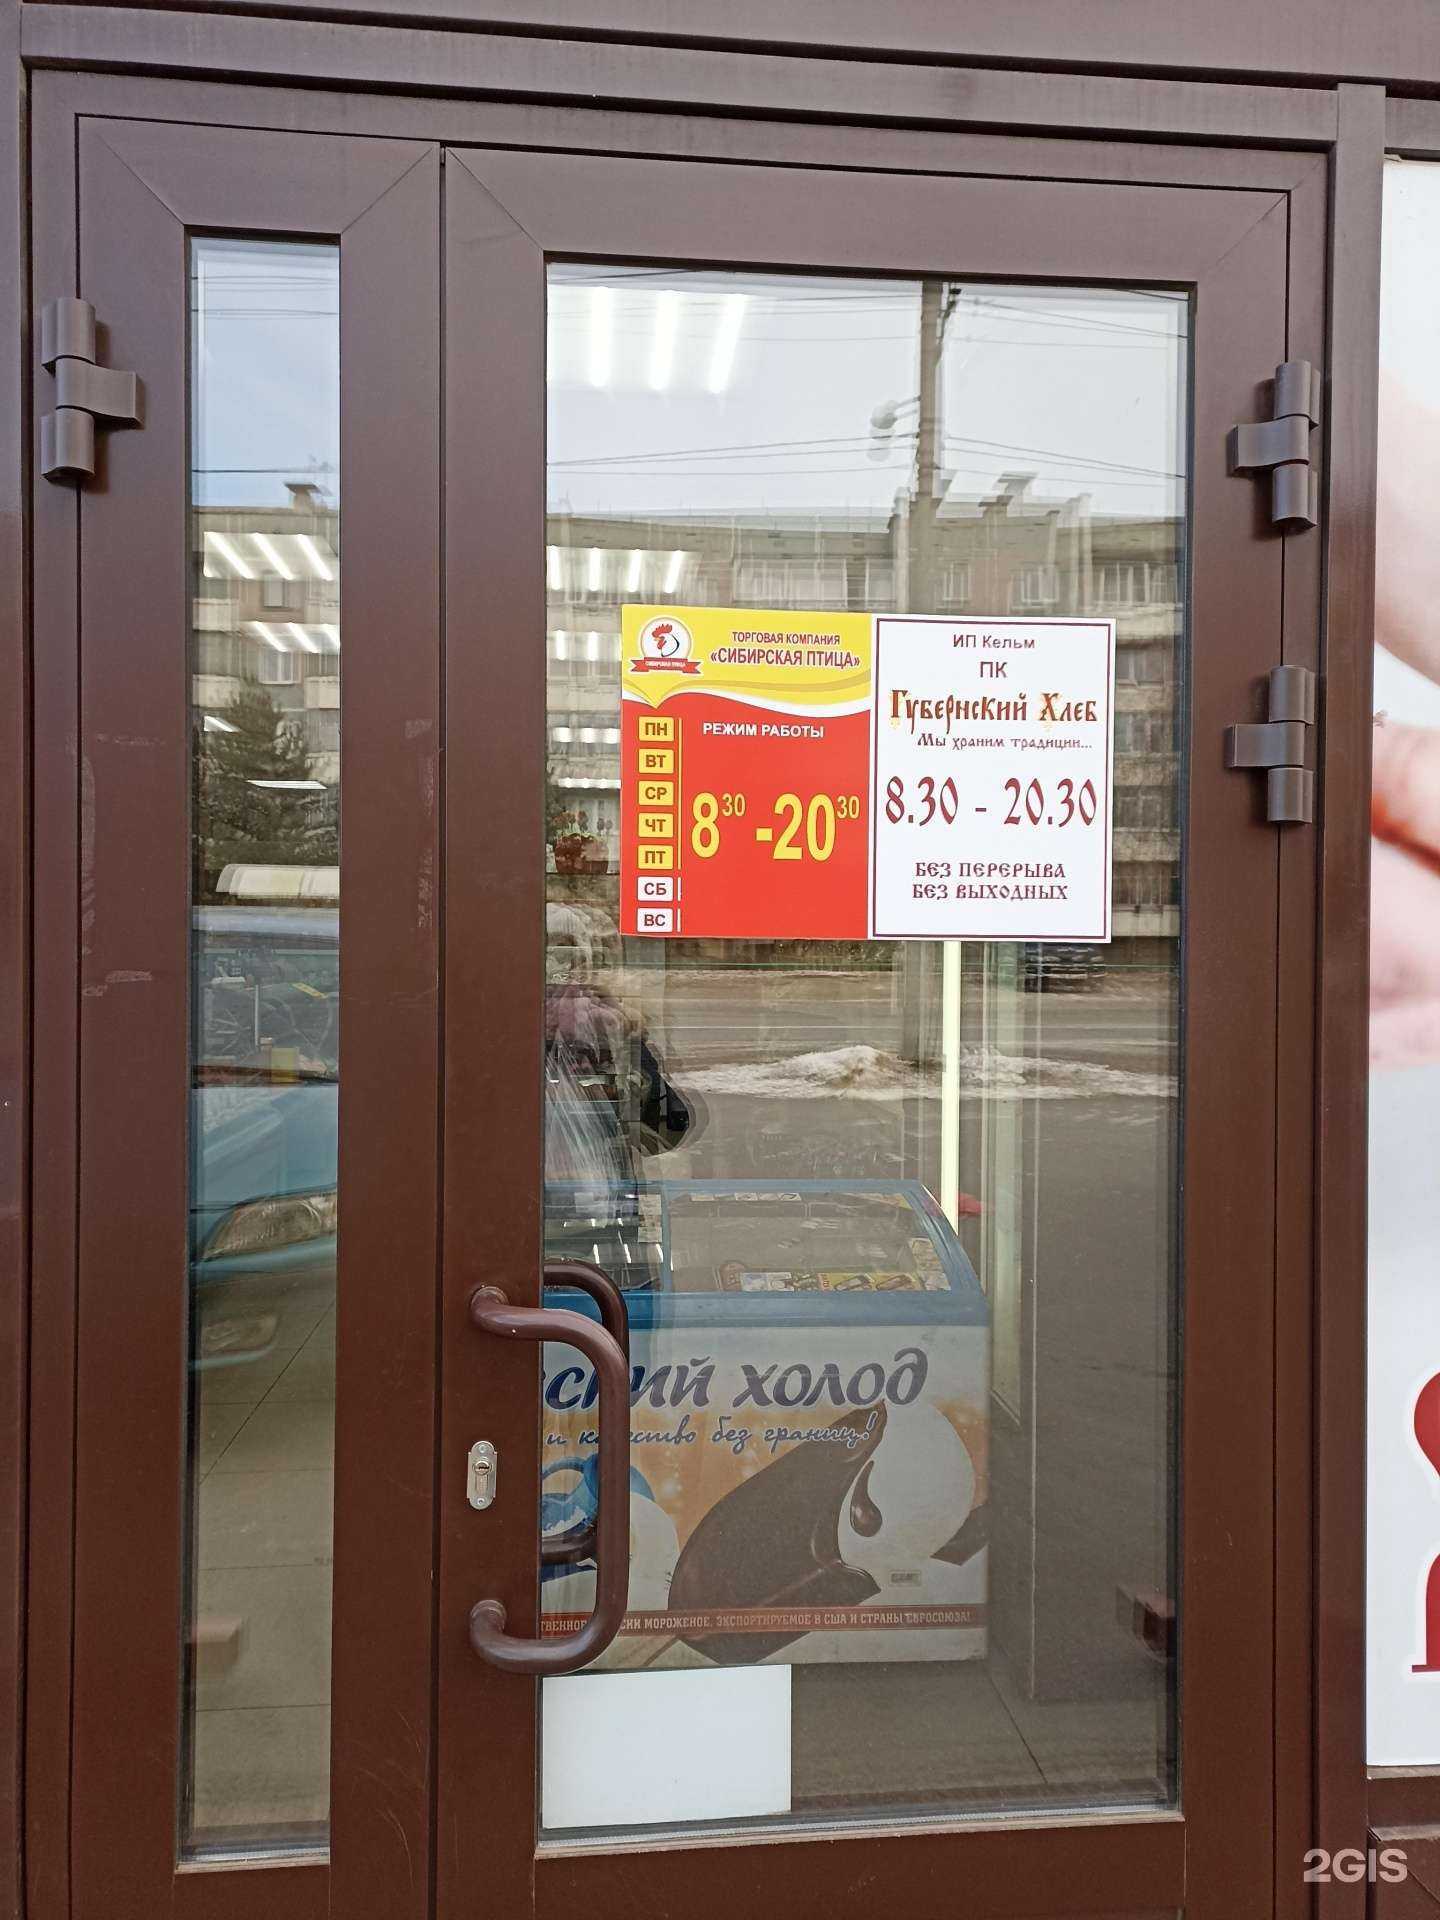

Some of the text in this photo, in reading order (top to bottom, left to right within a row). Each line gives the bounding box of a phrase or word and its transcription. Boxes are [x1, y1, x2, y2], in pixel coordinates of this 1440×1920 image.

[732, 631, 840, 646] ТОРГОВАЯ КОМПАНИЯ
[953, 634, 1035, 650] ИП Кельм
[710, 647, 860, 669] «СИБИРСКАЯ ПТИЦА»
[980, 661, 1008, 679] ПК
[890, 689, 1098, 735] Губернский Хлеб
[645, 722, 668, 737] ПН
[703, 722, 825, 738] РЕЖИМ РАБОТЫ
[917, 733, 946, 747] Мы
[952, 736, 1005, 750] храним
[645, 754, 666, 769] ВТ
[644, 786, 667, 801] СР
[885, 775, 959, 827] 8.30
[1003, 777, 1097, 828] 20.30
[645, 818, 666, 833] ЧТ
[644, 850, 666, 865] ПТ
[915, 862, 1066, 879] БЕЗ ПЕРЕРЫВА
[644, 882, 667, 897] СБ
[912, 884, 1068, 901] БЕЗ ВЫХОДНЫХ
[643, 914, 666, 927] ВС
[732, 1347, 929, 1408] холод
[712, 1415, 752, 1455] без
[824, 1614, 848, 1625] США
[860, 1613, 903, 1625] СТРАНЫ
